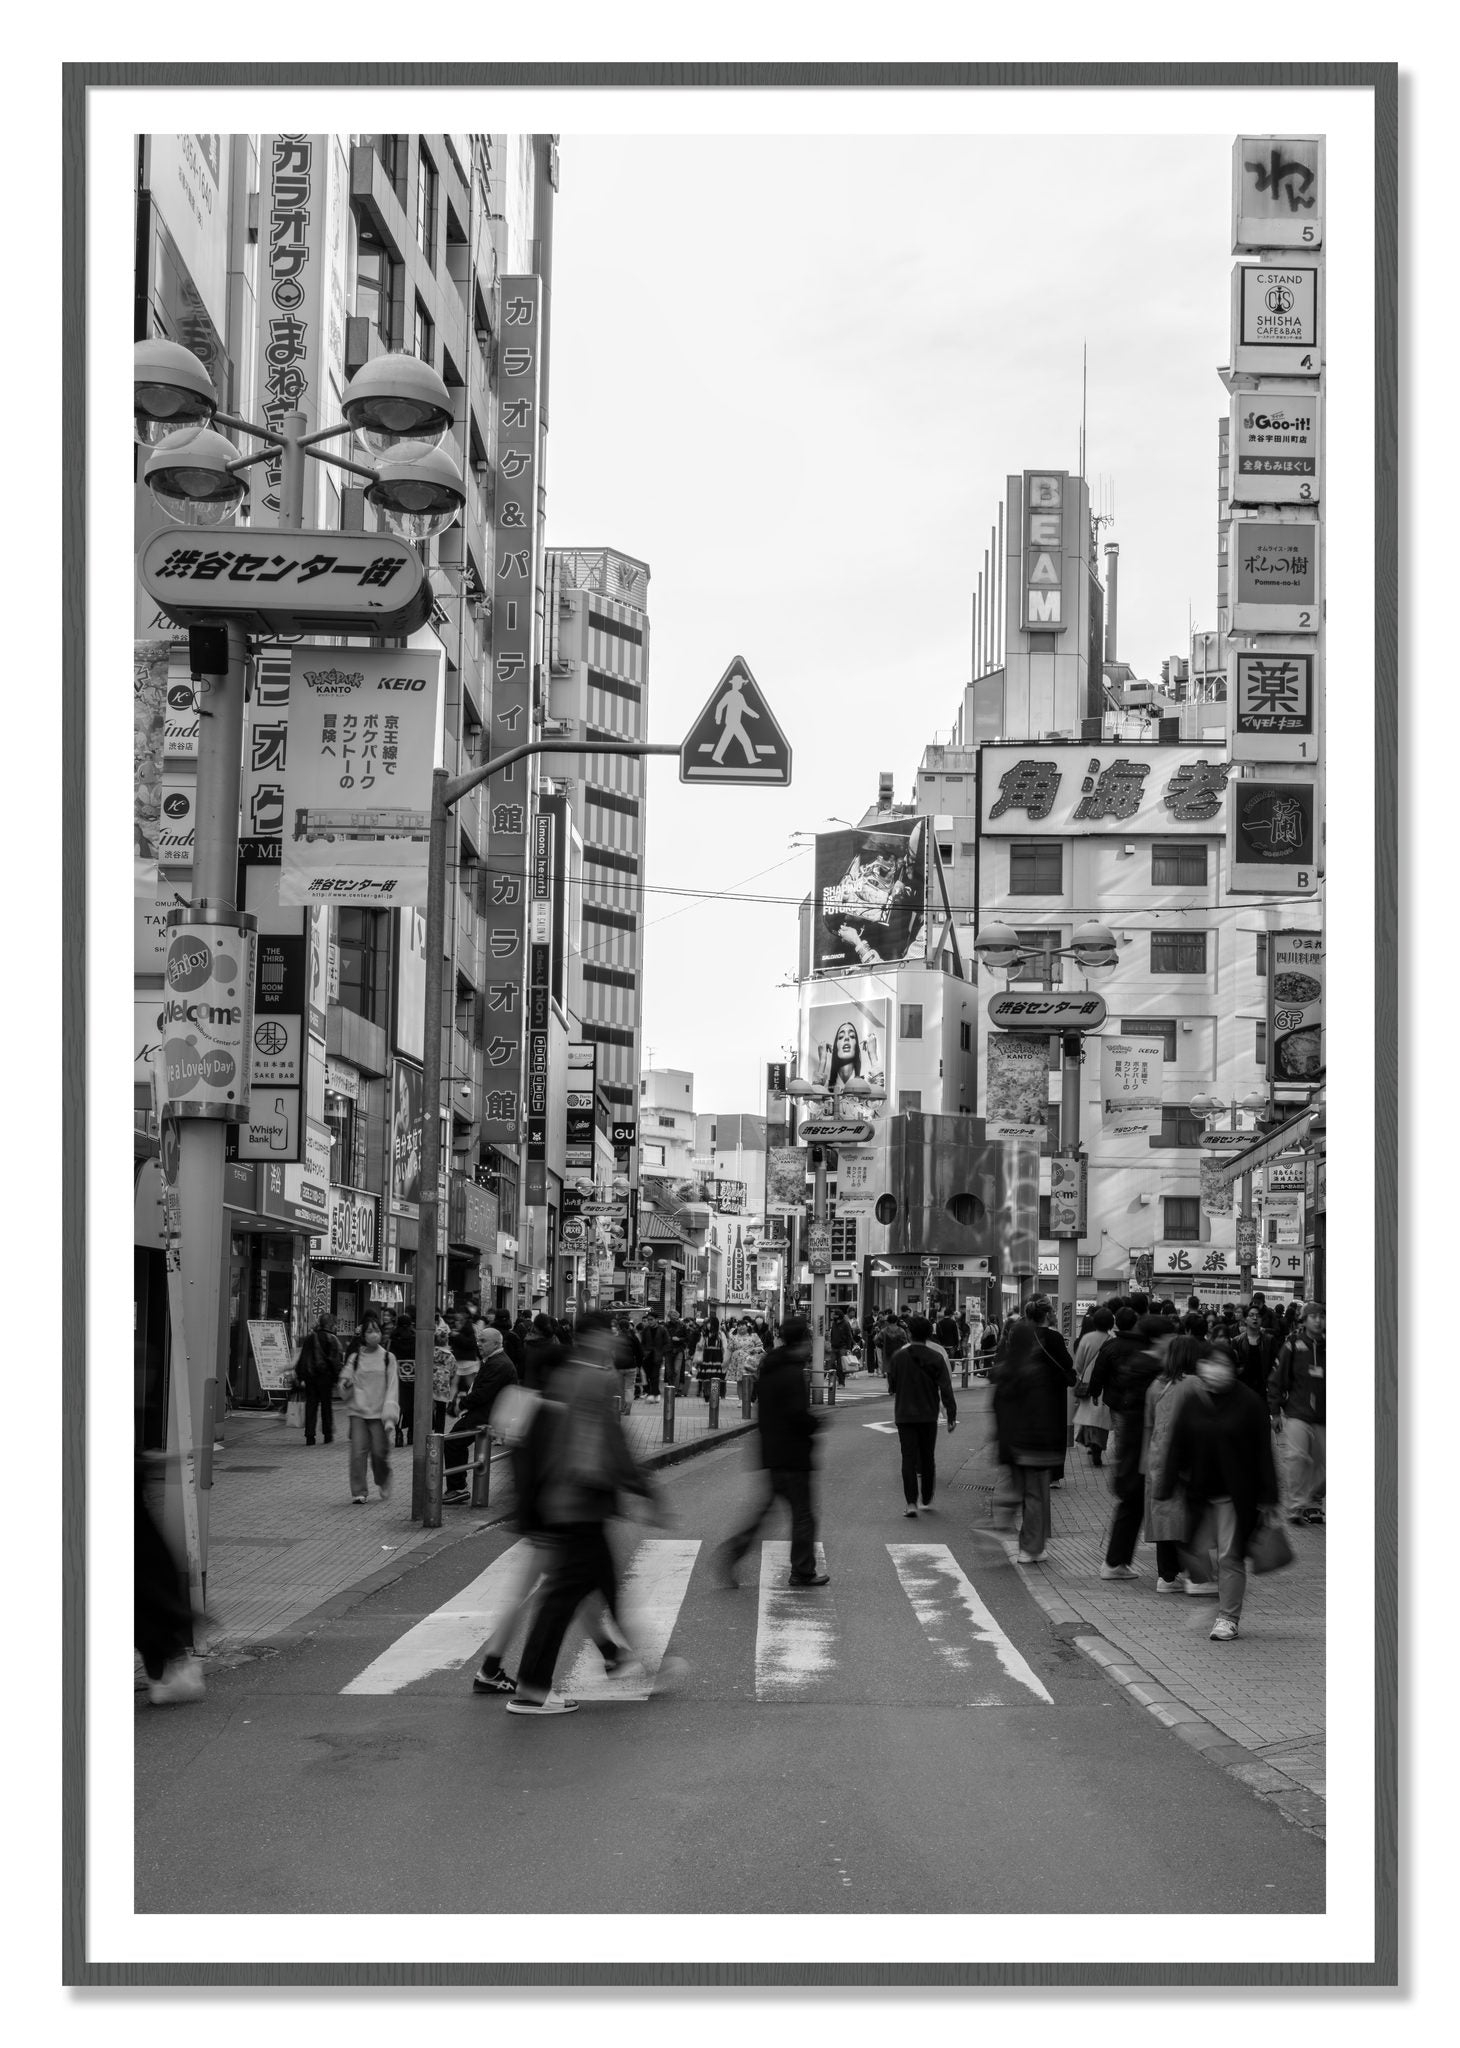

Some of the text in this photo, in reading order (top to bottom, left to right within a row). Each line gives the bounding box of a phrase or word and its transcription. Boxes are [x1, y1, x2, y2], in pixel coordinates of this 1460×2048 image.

[270, 139, 313, 282] カラオケ
[1302, 227, 1314, 242] 5
[1256, 275, 1303, 284] C.STAND
[1257, 316, 1302, 326] SHISHA
[1256, 327, 1302, 335] CAFE&BAR
[1301, 354, 1313, 370] 4
[1255, 414, 1310, 430] Goo-it!
[1248, 434, 1307, 443] 渋谷宇田川町店
[1243, 460, 1312, 472] 全身もみほぐし
[1299, 483, 1311, 499] 3
[1029, 476, 1062, 621] BEAM
[155, 549, 407, 587] 渋谷センター街
[1244, 554, 1309, 575] ポムの樹
[1299, 612, 1311, 628] 2
[377, 678, 426, 691] KEIO
[1247, 661, 1299, 713] 薬
[1242, 716, 1304, 730] マツモトキヨシ
[320, 714, 337, 757] 冒険へ
[168, 742, 194, 751] 渋谷店
[340, 714, 358, 789] カントーの
[360, 714, 378, 789] ポケパーク
[382, 715, 399, 775] 京王線で
[1298, 742, 1307, 757] 1
[989, 759, 1232, 820] 角海老
[1241, 798, 1303, 848] 一蘭
[164, 850, 189, 859] 渋谷店
[537, 819, 548, 895] kimono hearts
[308, 879, 398, 892] 渋谷センター街
[1297, 872, 1309, 888] B
[167, 949, 209, 984] Enjoy
[164, 1000, 242, 1025] Welcome
[996, 1001, 1100, 1015] 渋谷センター街
[1274, 1010, 1304, 1030] 6F
[193, 1020, 213, 1040] Shibuya
[175, 1063, 181, 1079] a
[181, 1058, 213, 1078] Lovely
[213, 1059, 235, 1074] Day!
[250, 1126, 284, 1136] Whisky
[614, 1129, 635, 1140] GU
[802, 1125, 866, 1135] 渋谷センター街
[249, 1135, 270, 1143] Bank
[733, 1247, 744, 1291] BEER
